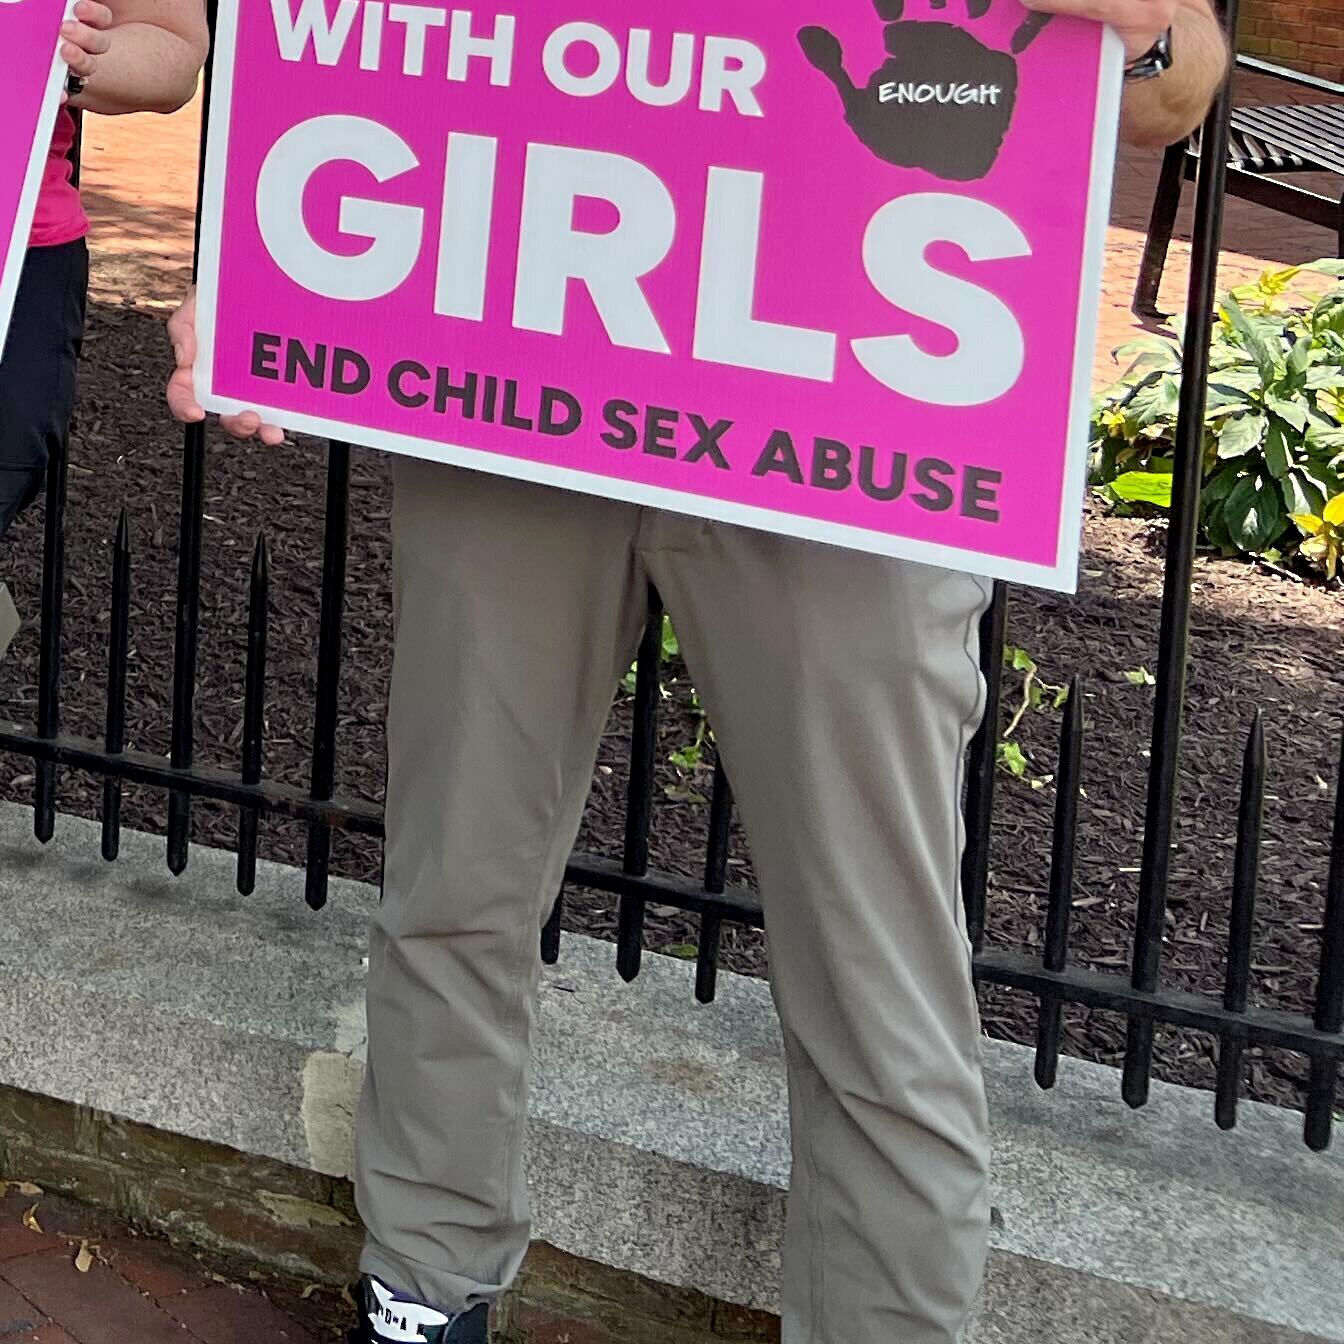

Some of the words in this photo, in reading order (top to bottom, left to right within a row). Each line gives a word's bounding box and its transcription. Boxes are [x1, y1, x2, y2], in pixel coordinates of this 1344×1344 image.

[541, 20, 768, 118] OUR
[878, 81, 1001, 105] ENOUGH
[254, 112, 1034, 408] GIRLS
[250, 331, 372, 396] END
[386, 360, 584, 437] CHILD
[601, 398, 734, 470] SEX
[753, 429, 1002, 522] ABUSE
